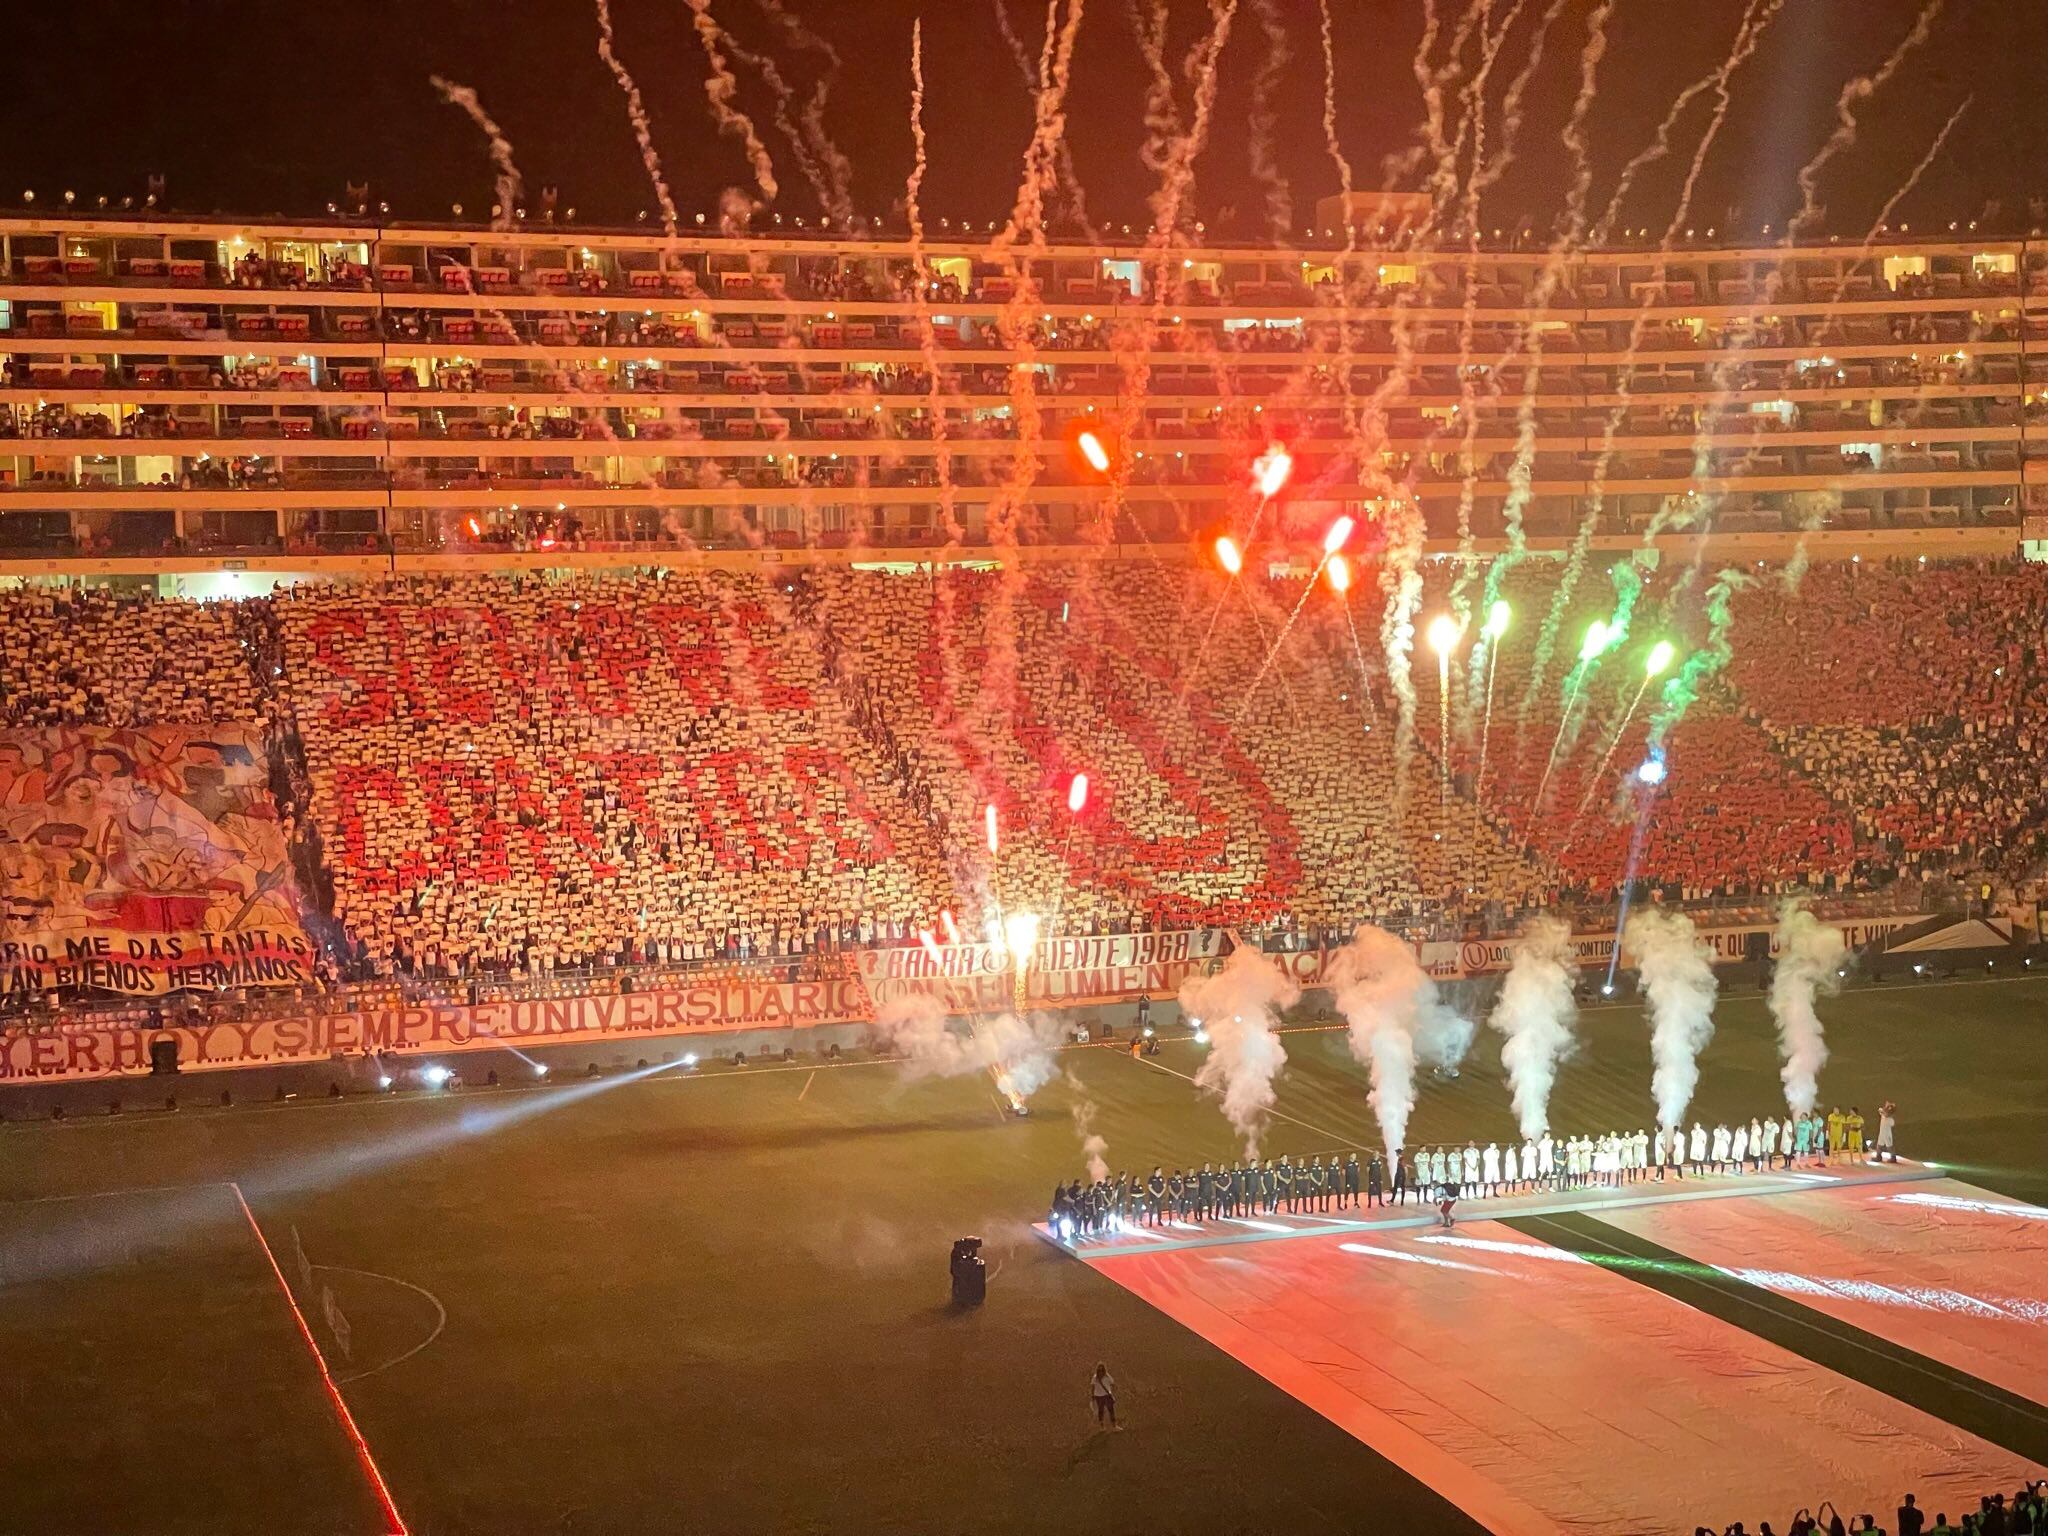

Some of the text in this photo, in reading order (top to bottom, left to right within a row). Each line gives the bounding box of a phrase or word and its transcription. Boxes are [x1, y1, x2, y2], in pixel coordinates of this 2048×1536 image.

[65, 936, 111, 961] ME
[128, 937, 183, 960] DAS
[200, 930, 307, 956] TANTAS
[1129, 932, 1189, 965] 1968
[56, 959, 155, 991] BUENOS
[167, 956, 304, 987] HERMANOS
